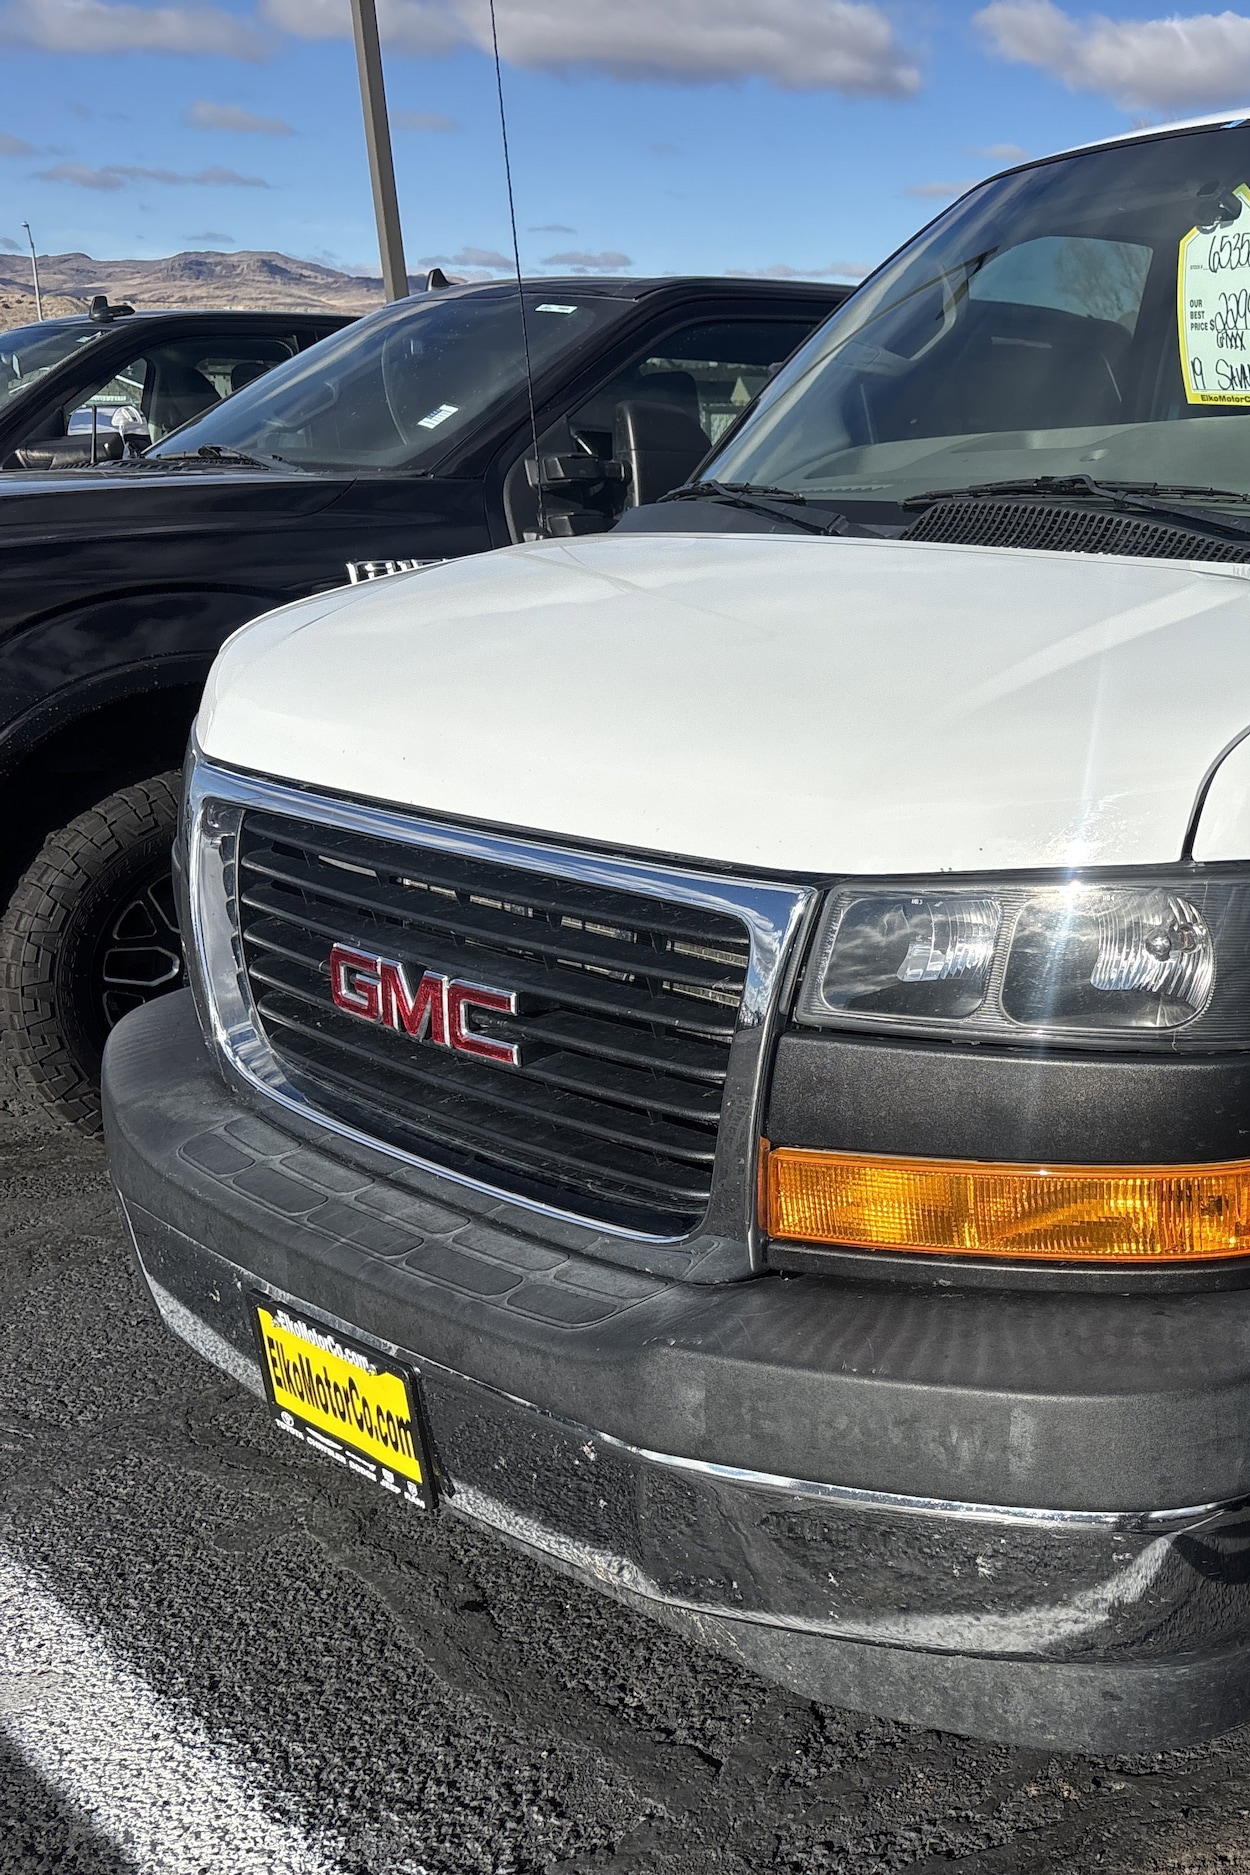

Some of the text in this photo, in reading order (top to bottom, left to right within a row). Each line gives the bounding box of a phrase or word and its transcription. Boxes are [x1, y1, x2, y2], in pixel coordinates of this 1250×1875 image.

[1190, 299, 1203, 308] OUR
[1190, 311, 1205, 320] BEST
[1190, 322, 1209, 331] PRICE
[1191, 357, 1206, 390] 19
[330, 942, 522, 1067] GMC
[276, 1308, 369, 1370] ElkoMotorCo.com
[267, 1335, 413, 1459] ElkoMotorCo.com
